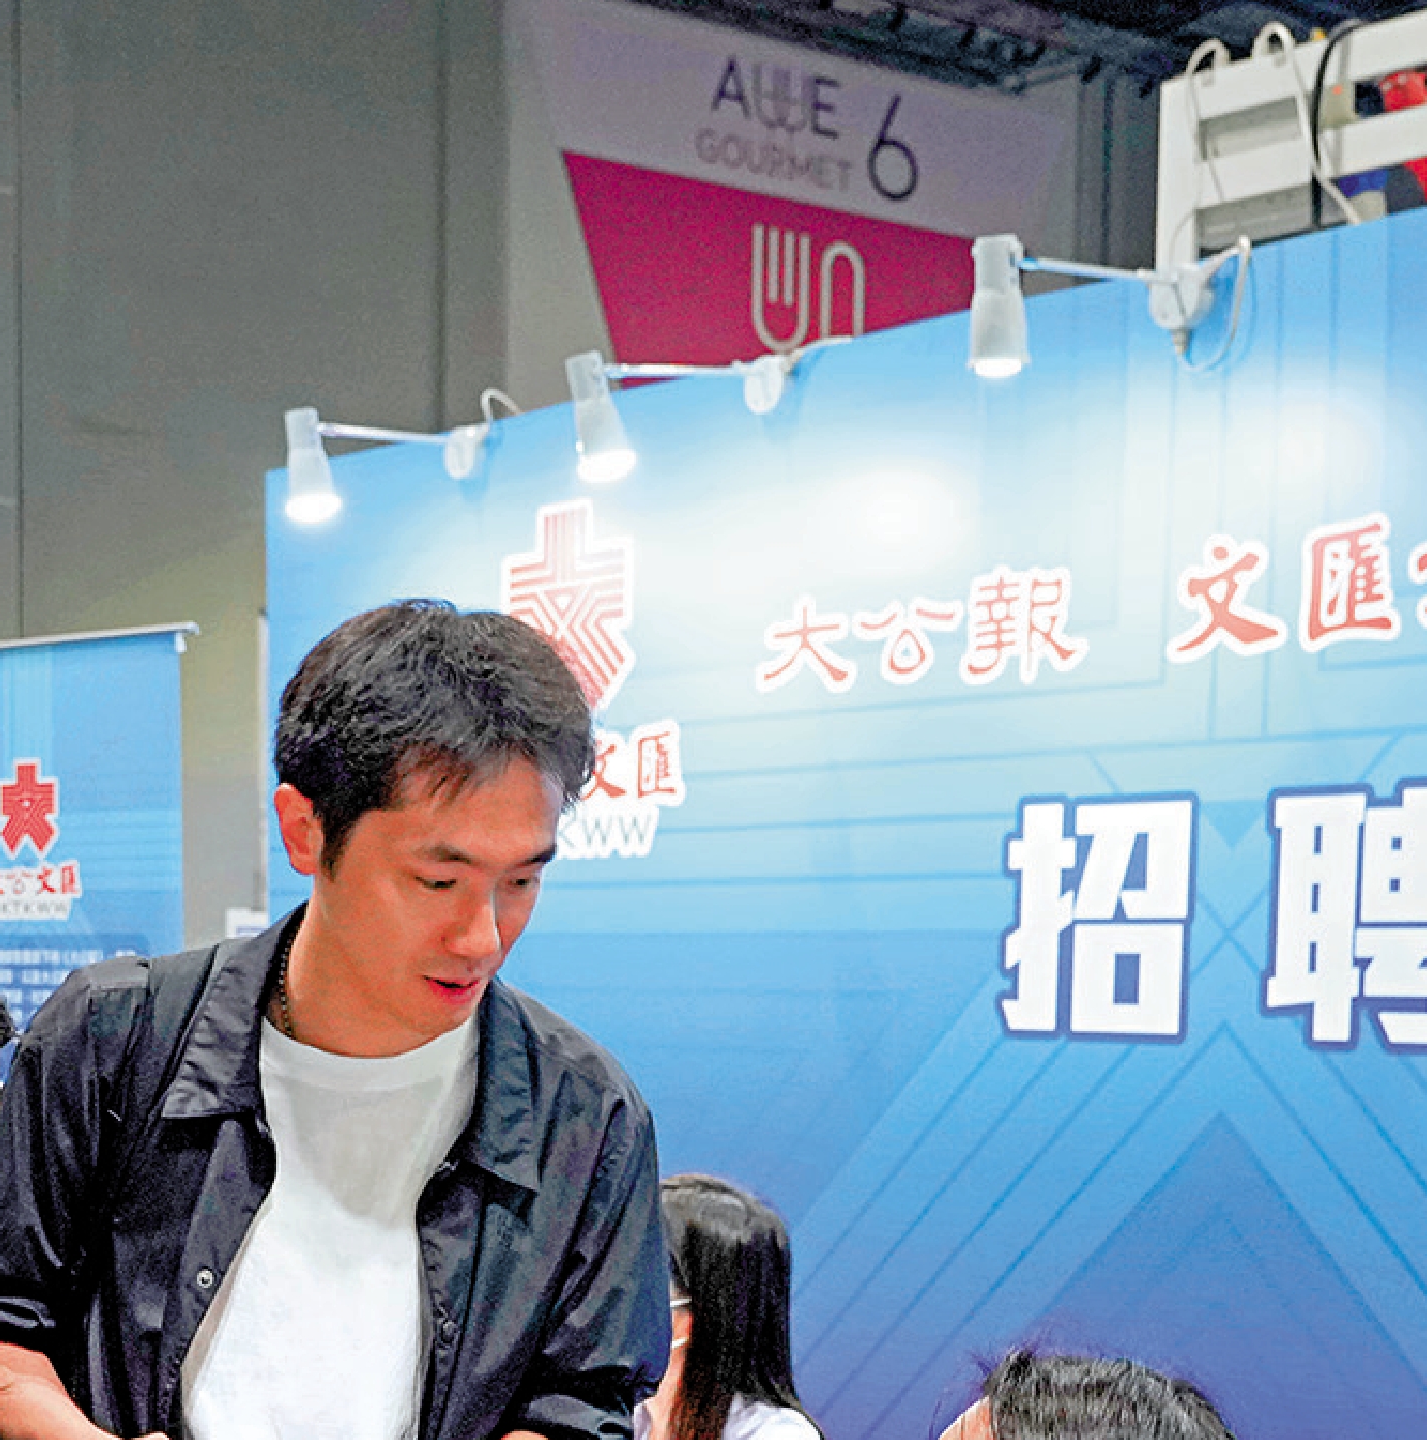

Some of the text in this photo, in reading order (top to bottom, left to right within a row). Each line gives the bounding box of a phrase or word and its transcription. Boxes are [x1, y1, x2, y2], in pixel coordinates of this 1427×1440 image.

[695, 127, 852, 191] GOURMET
[867, 92, 919, 202] 6
[763, 576, 1078, 684] 大公報
